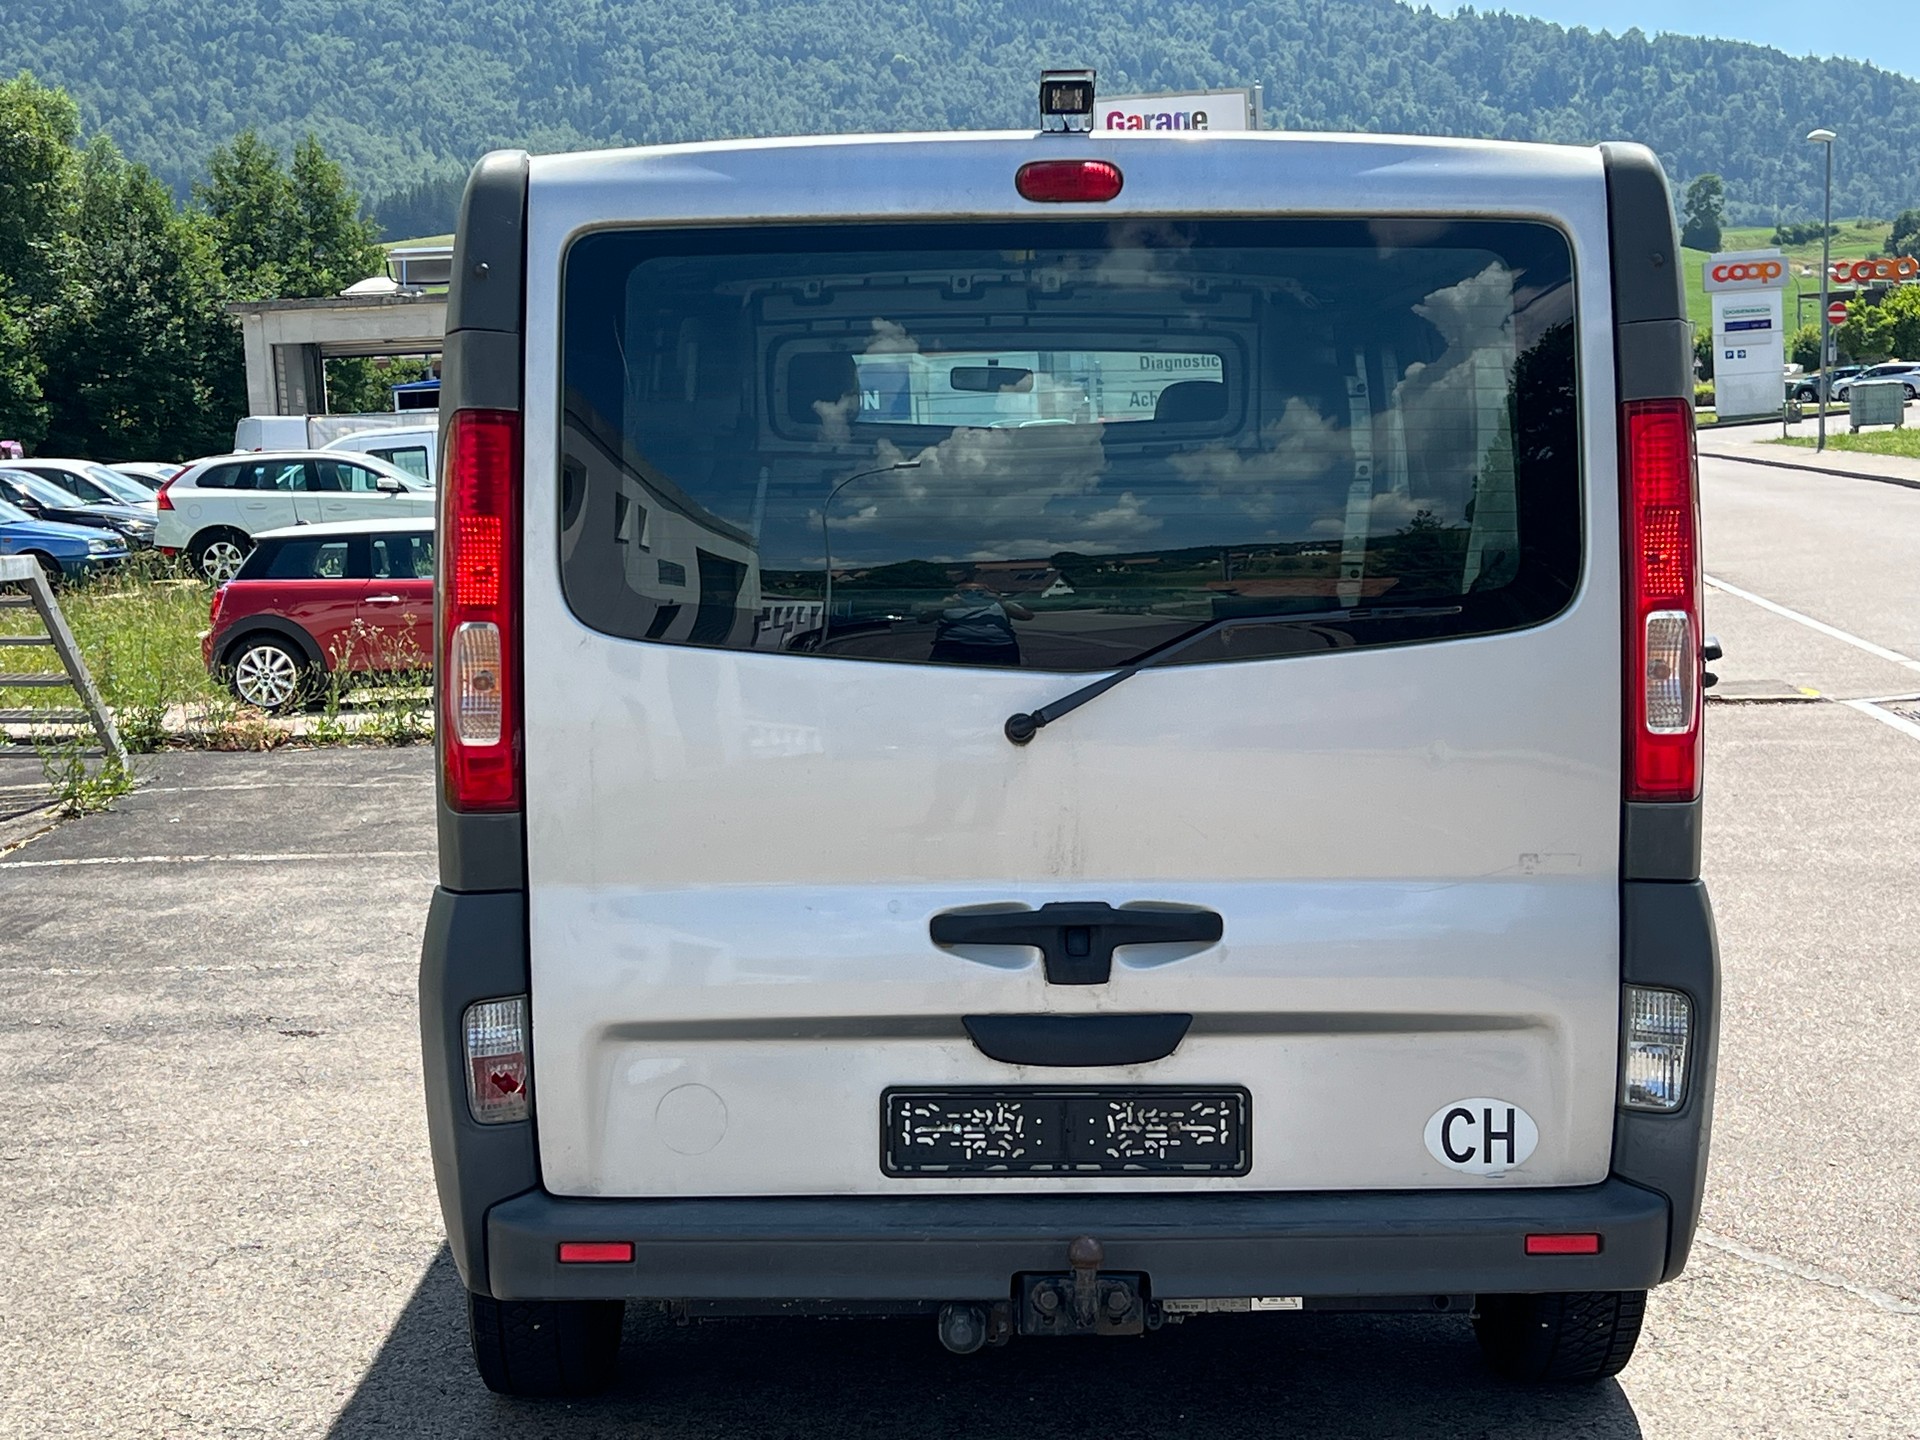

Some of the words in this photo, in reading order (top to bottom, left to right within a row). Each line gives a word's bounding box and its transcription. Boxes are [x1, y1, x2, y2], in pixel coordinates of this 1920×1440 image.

[1711, 261, 1782, 284] coop
[1828, 256, 1919, 285] coop
[1140, 355, 1219, 372] Diagnostic
[860, 390, 880, 410] N
[1129, 390, 1158, 407] Ach
[1441, 1107, 1515, 1164] CH
